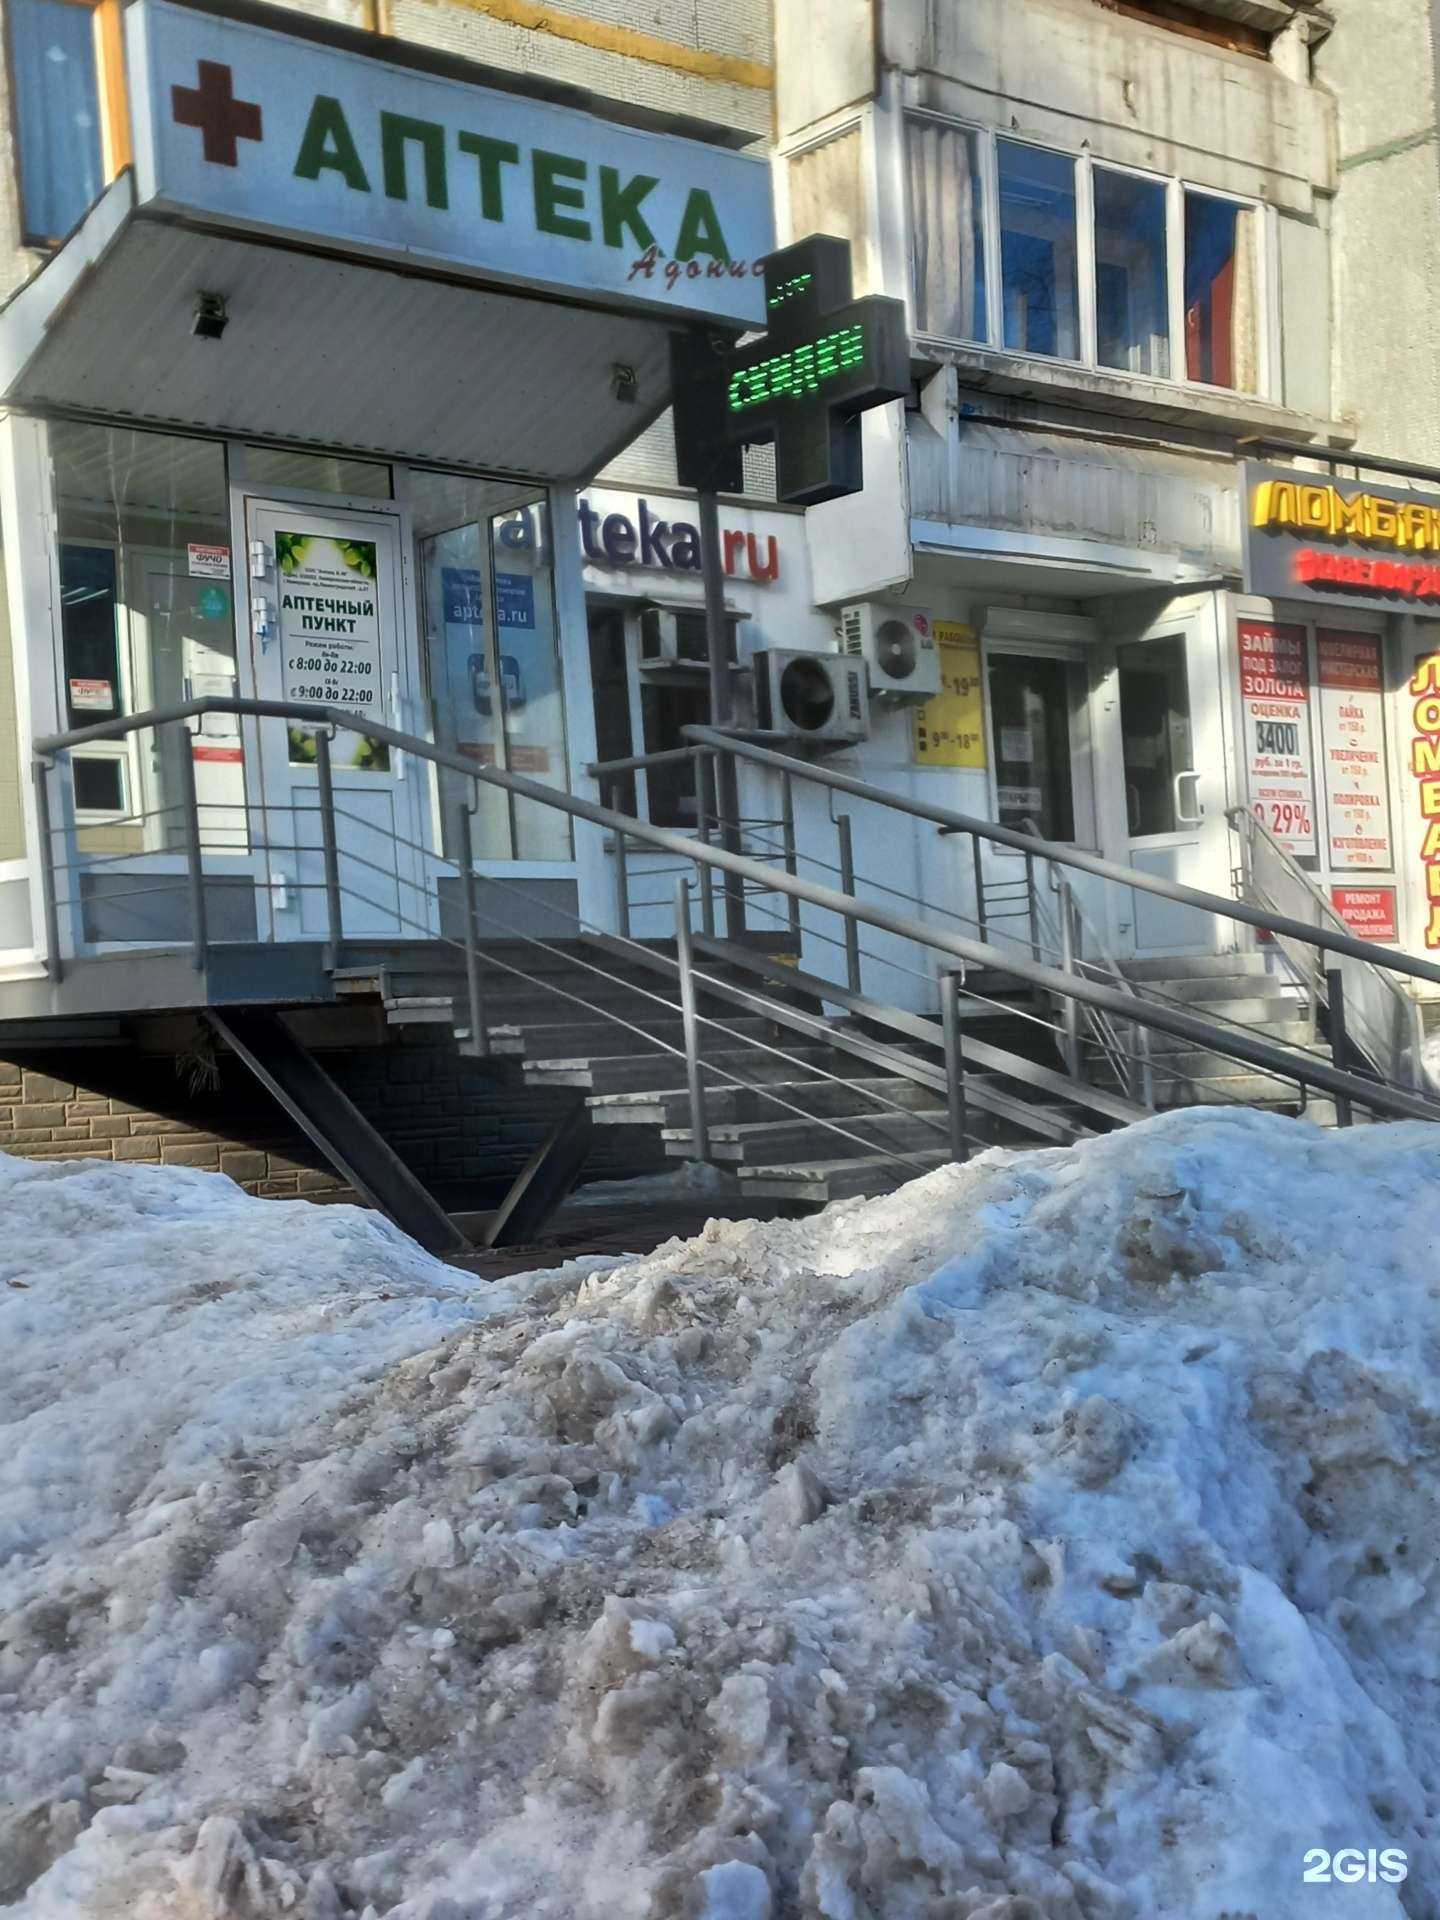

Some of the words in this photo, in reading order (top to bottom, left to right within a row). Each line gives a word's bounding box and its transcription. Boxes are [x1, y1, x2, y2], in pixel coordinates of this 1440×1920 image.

[293, 94, 732, 268] АПТЕКА
[1254, 480, 1440, 550] ЛОМБА
[282, 594, 374, 617] АПТЕЧНЫЙ
[302, 615, 356, 633] ПУНКТ
[1242, 632, 1302, 655] ЗАЙМЫ
[296, 657, 322, 671] 8:00
[324, 659, 338, 672] до
[340, 661, 372, 674] 22:00
[1243, 656, 1268, 675] ПОД
[298, 686, 323, 699] 9:00
[325, 687, 339, 700] до
[341, 688, 373, 702] 22:00
[1244, 676, 1305, 697] ЗОЛОТА
[1250, 703, 1301, 719] ОЦЕНКА
[1342, 908, 1386, 922] ПРОДАЖА
